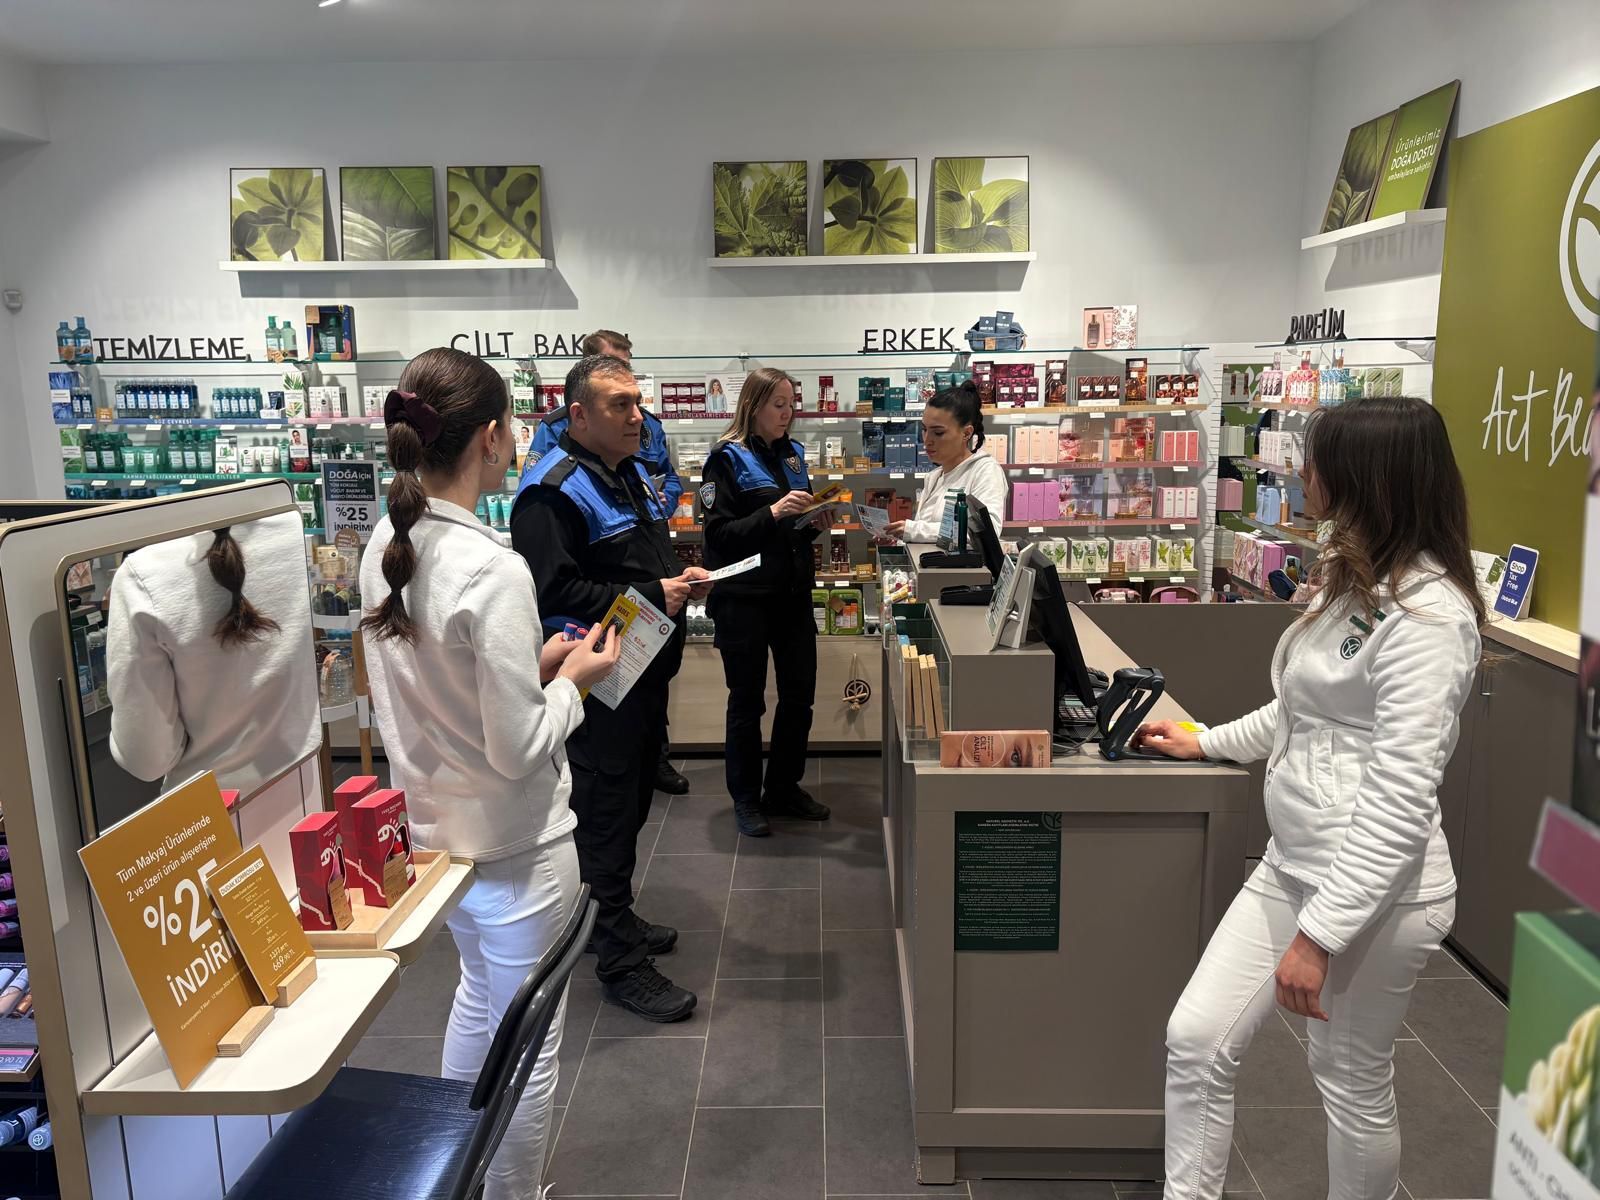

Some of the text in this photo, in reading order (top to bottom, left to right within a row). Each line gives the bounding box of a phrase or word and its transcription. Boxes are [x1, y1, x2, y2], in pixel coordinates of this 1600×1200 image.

[1395, 127, 1441, 154] Ürünlerimiz
[1391, 143, 1438, 171] DOĞA DOSTU
[93, 334, 247, 360] TEMİZLEME
[864, 327, 955, 351] ERKEK
[1482, 366, 1549, 462] Act
[329, 468, 372, 480] DOĞA İÇİN
[335, 506, 368, 521] %25
[1509, 571, 1518, 580] Tax
[1511, 561, 1525, 574] Shop
[1506, 580, 1519, 591] Free
[116, 814, 212, 884] Tüm Makyaj Ürünlerinde
[126, 833, 218, 903] 2 ve üzeri ürün alışverişine
[166, 929, 236, 1008] İNDİRİ
